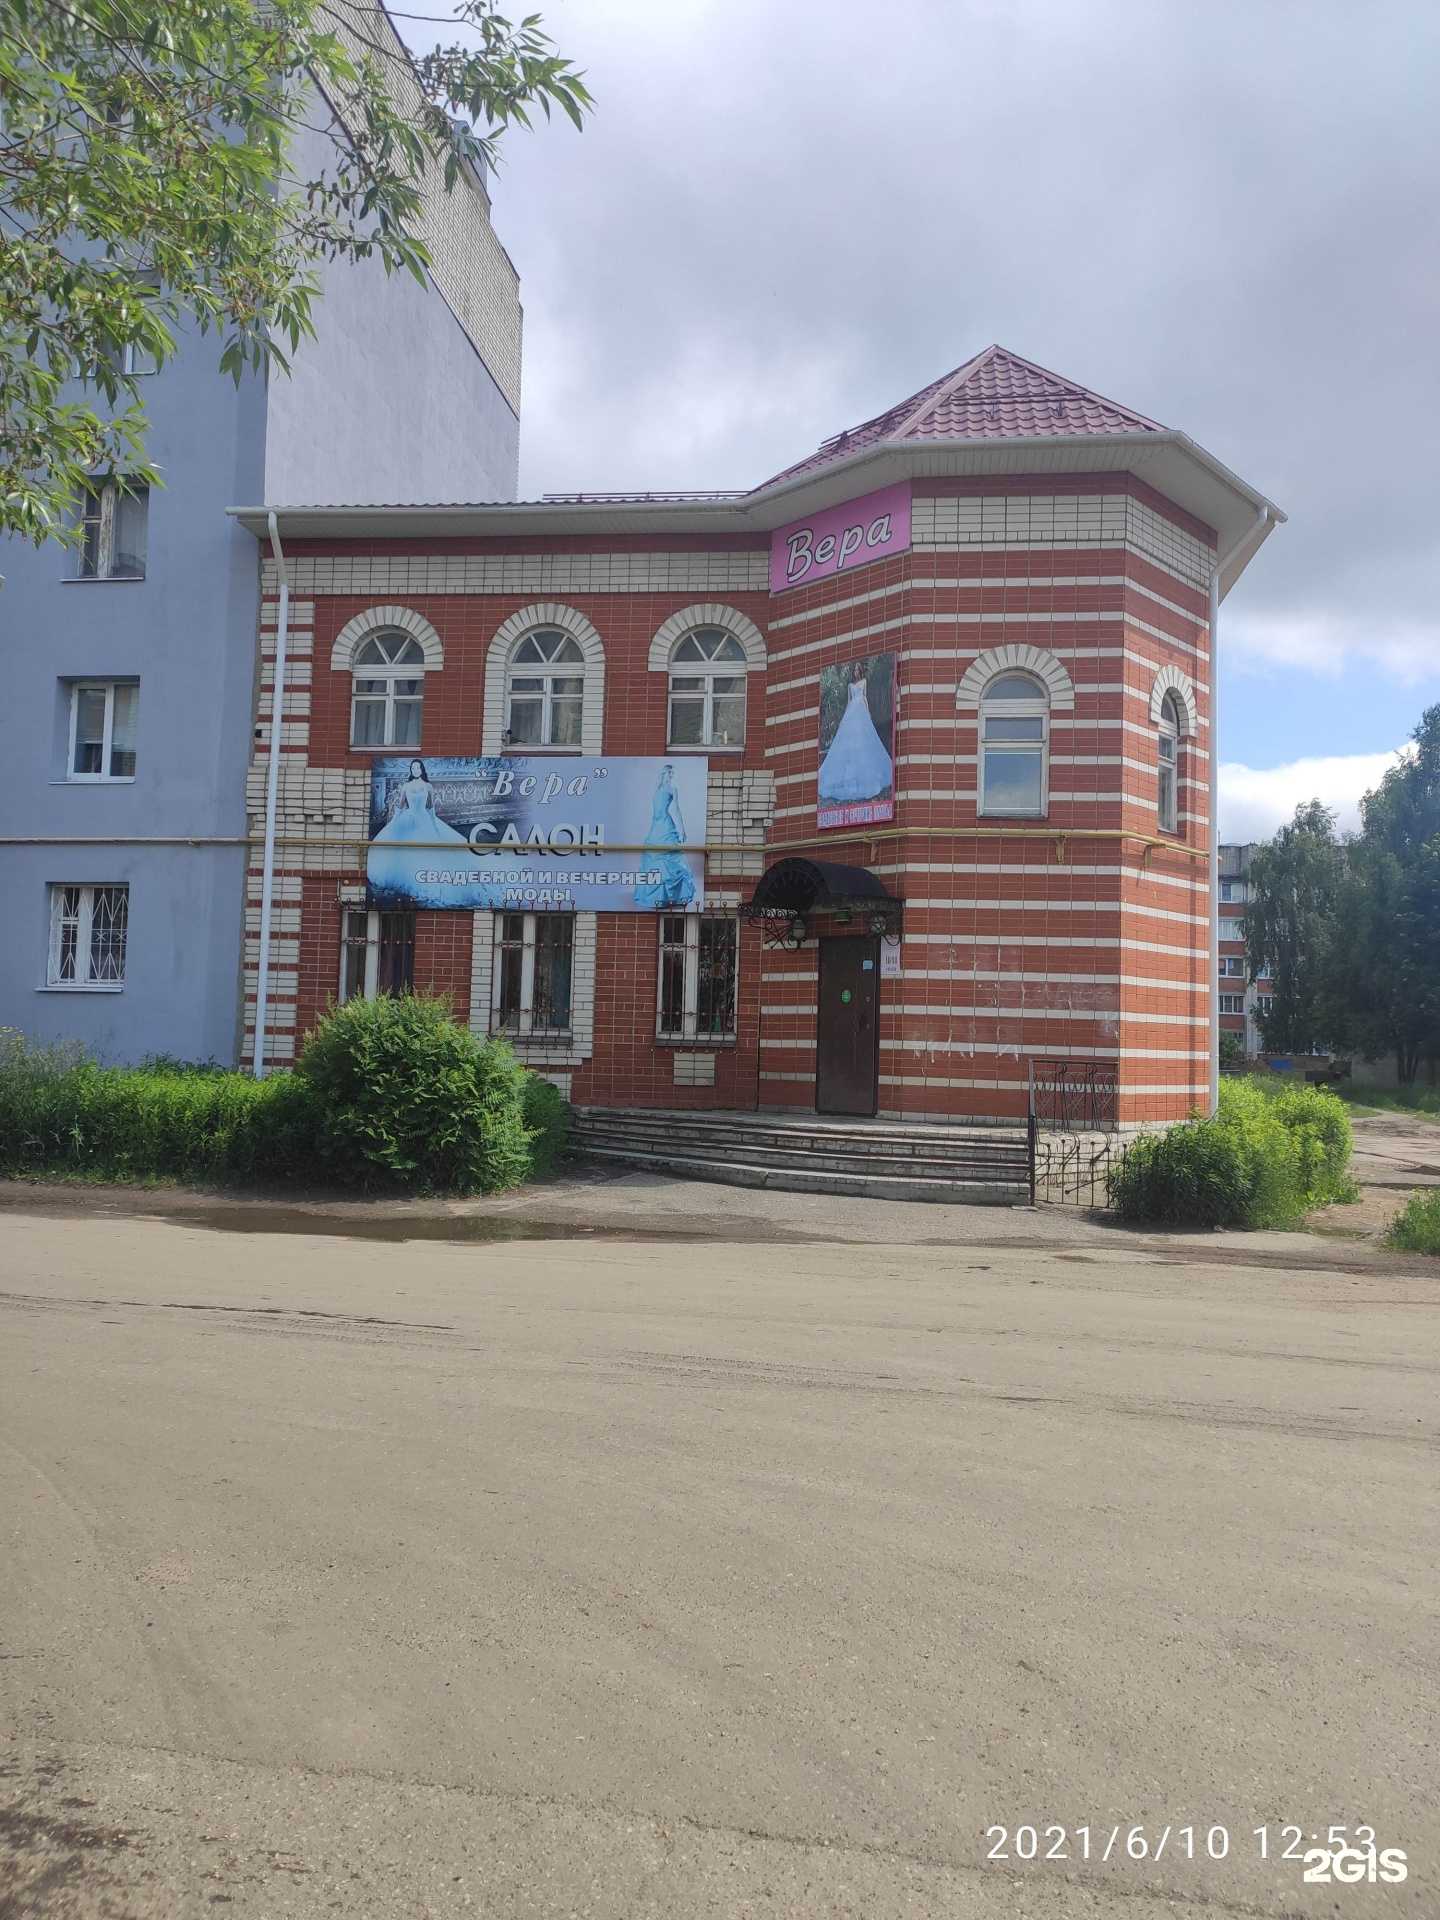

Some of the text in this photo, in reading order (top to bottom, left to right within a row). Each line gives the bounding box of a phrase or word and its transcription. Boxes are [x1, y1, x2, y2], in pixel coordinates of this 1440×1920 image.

[786, 513, 893, 583] Вера
[467, 822, 606, 857] САЛОН
[414, 868, 663, 886] СВАДЕБНОЙ И ВЕЧЕРНЕЙ
[504, 888, 572, 903] МОДЫ
